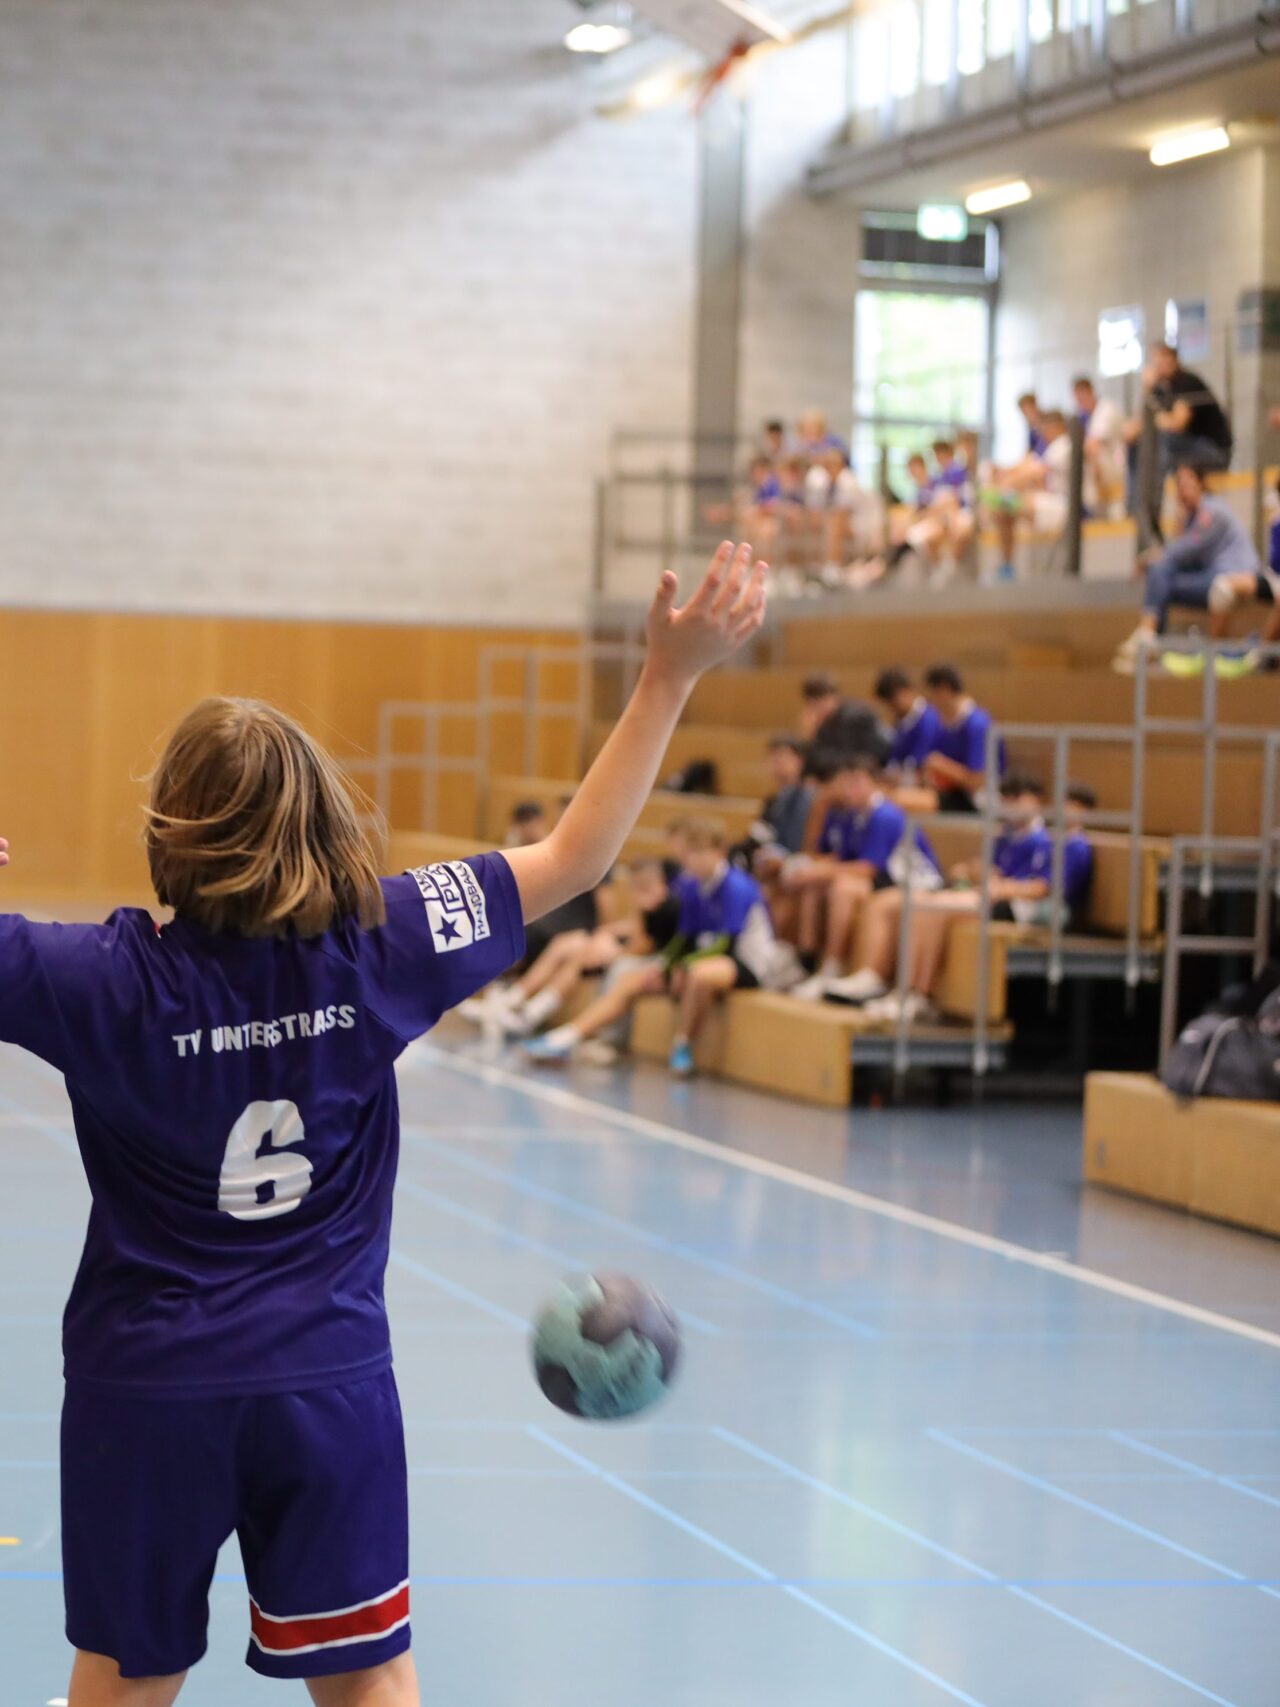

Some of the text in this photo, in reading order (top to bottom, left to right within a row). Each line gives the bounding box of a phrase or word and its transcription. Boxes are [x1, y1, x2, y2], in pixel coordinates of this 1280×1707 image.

[172, 1004, 356, 1057] TV UNTERSTRASS
[218, 1099, 314, 1221] 6
